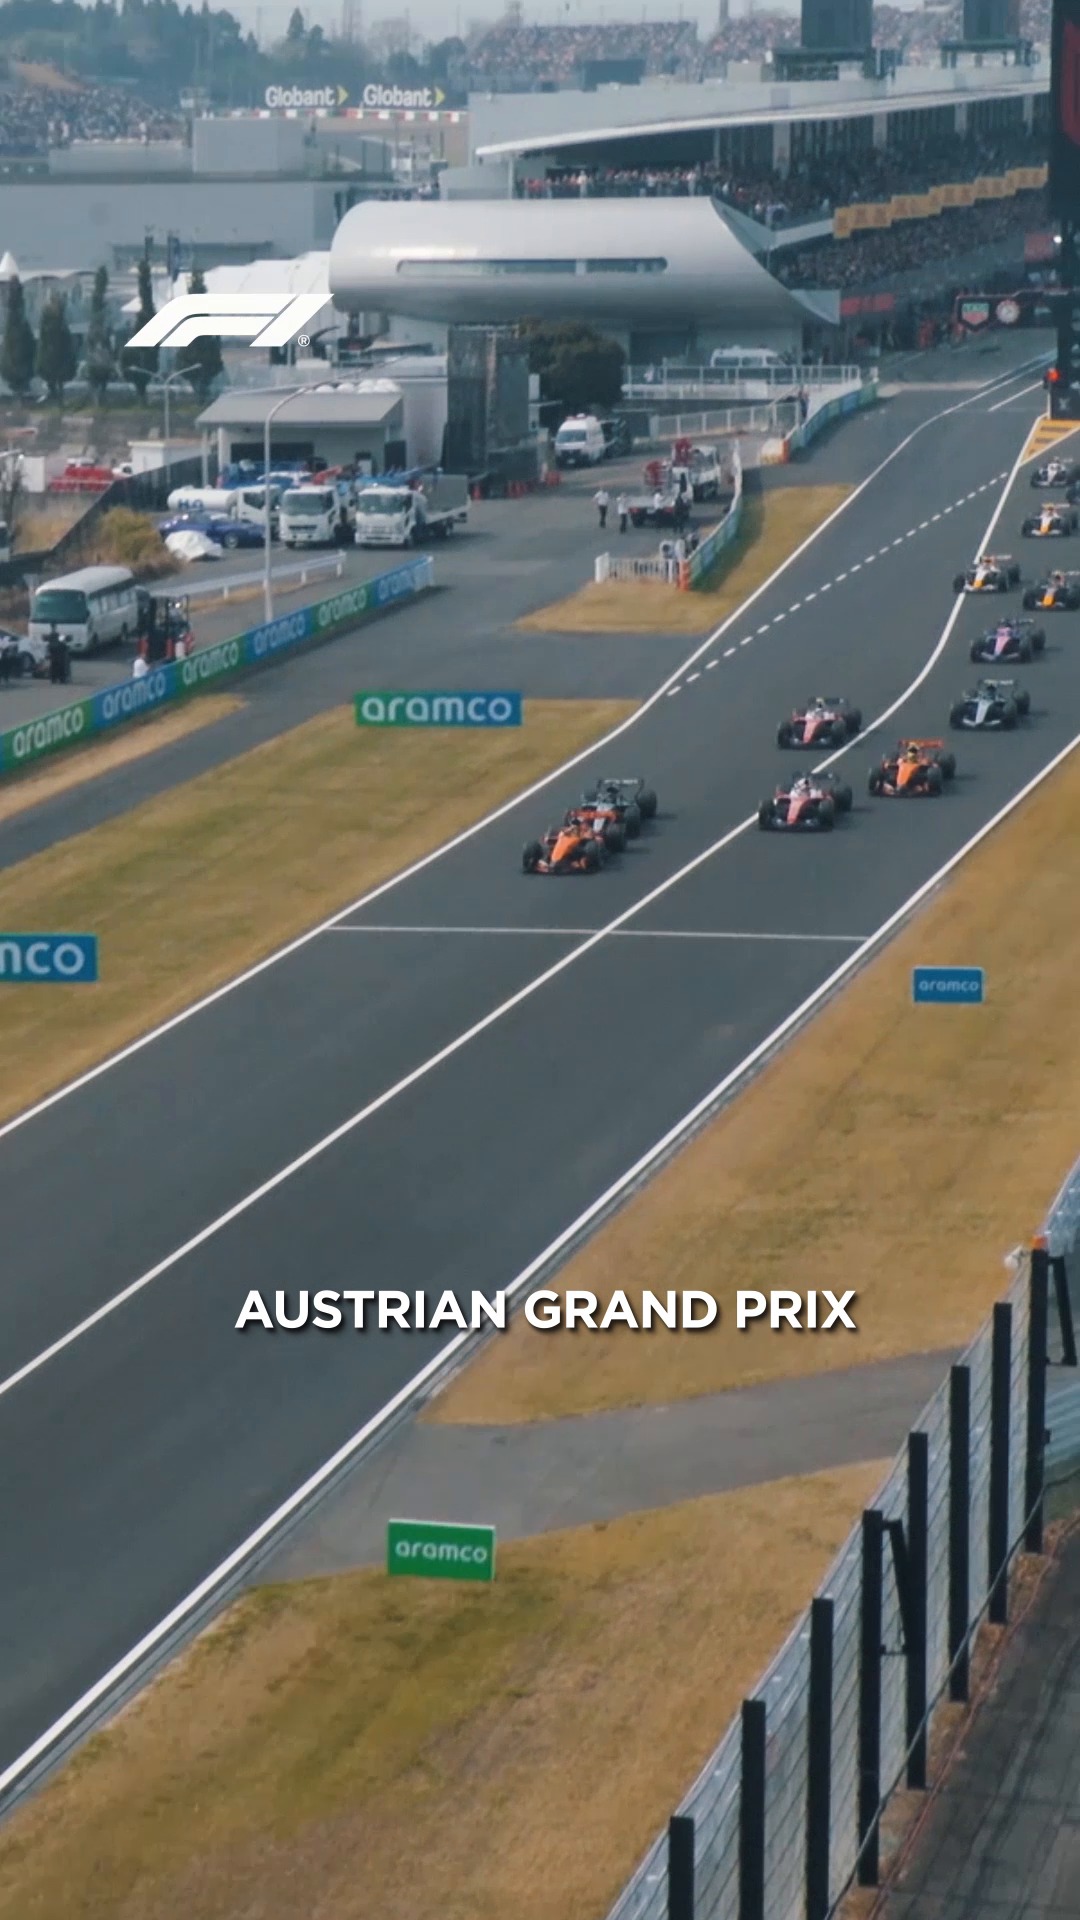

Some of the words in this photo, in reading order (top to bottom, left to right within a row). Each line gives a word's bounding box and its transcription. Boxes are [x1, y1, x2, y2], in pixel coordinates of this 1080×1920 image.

[265, 85, 336, 107] Globant
[363, 84, 432, 107] Globant
[318, 587, 368, 626] aramco
[253, 613, 306, 655] aramco
[182, 642, 240, 685] aramco
[102, 672, 167, 719] aramco
[361, 696, 512, 722] aramco
[12, 707, 85, 758] aramco
[918, 980, 980, 992] aramco
[395, 1540, 488, 1563] aramco
